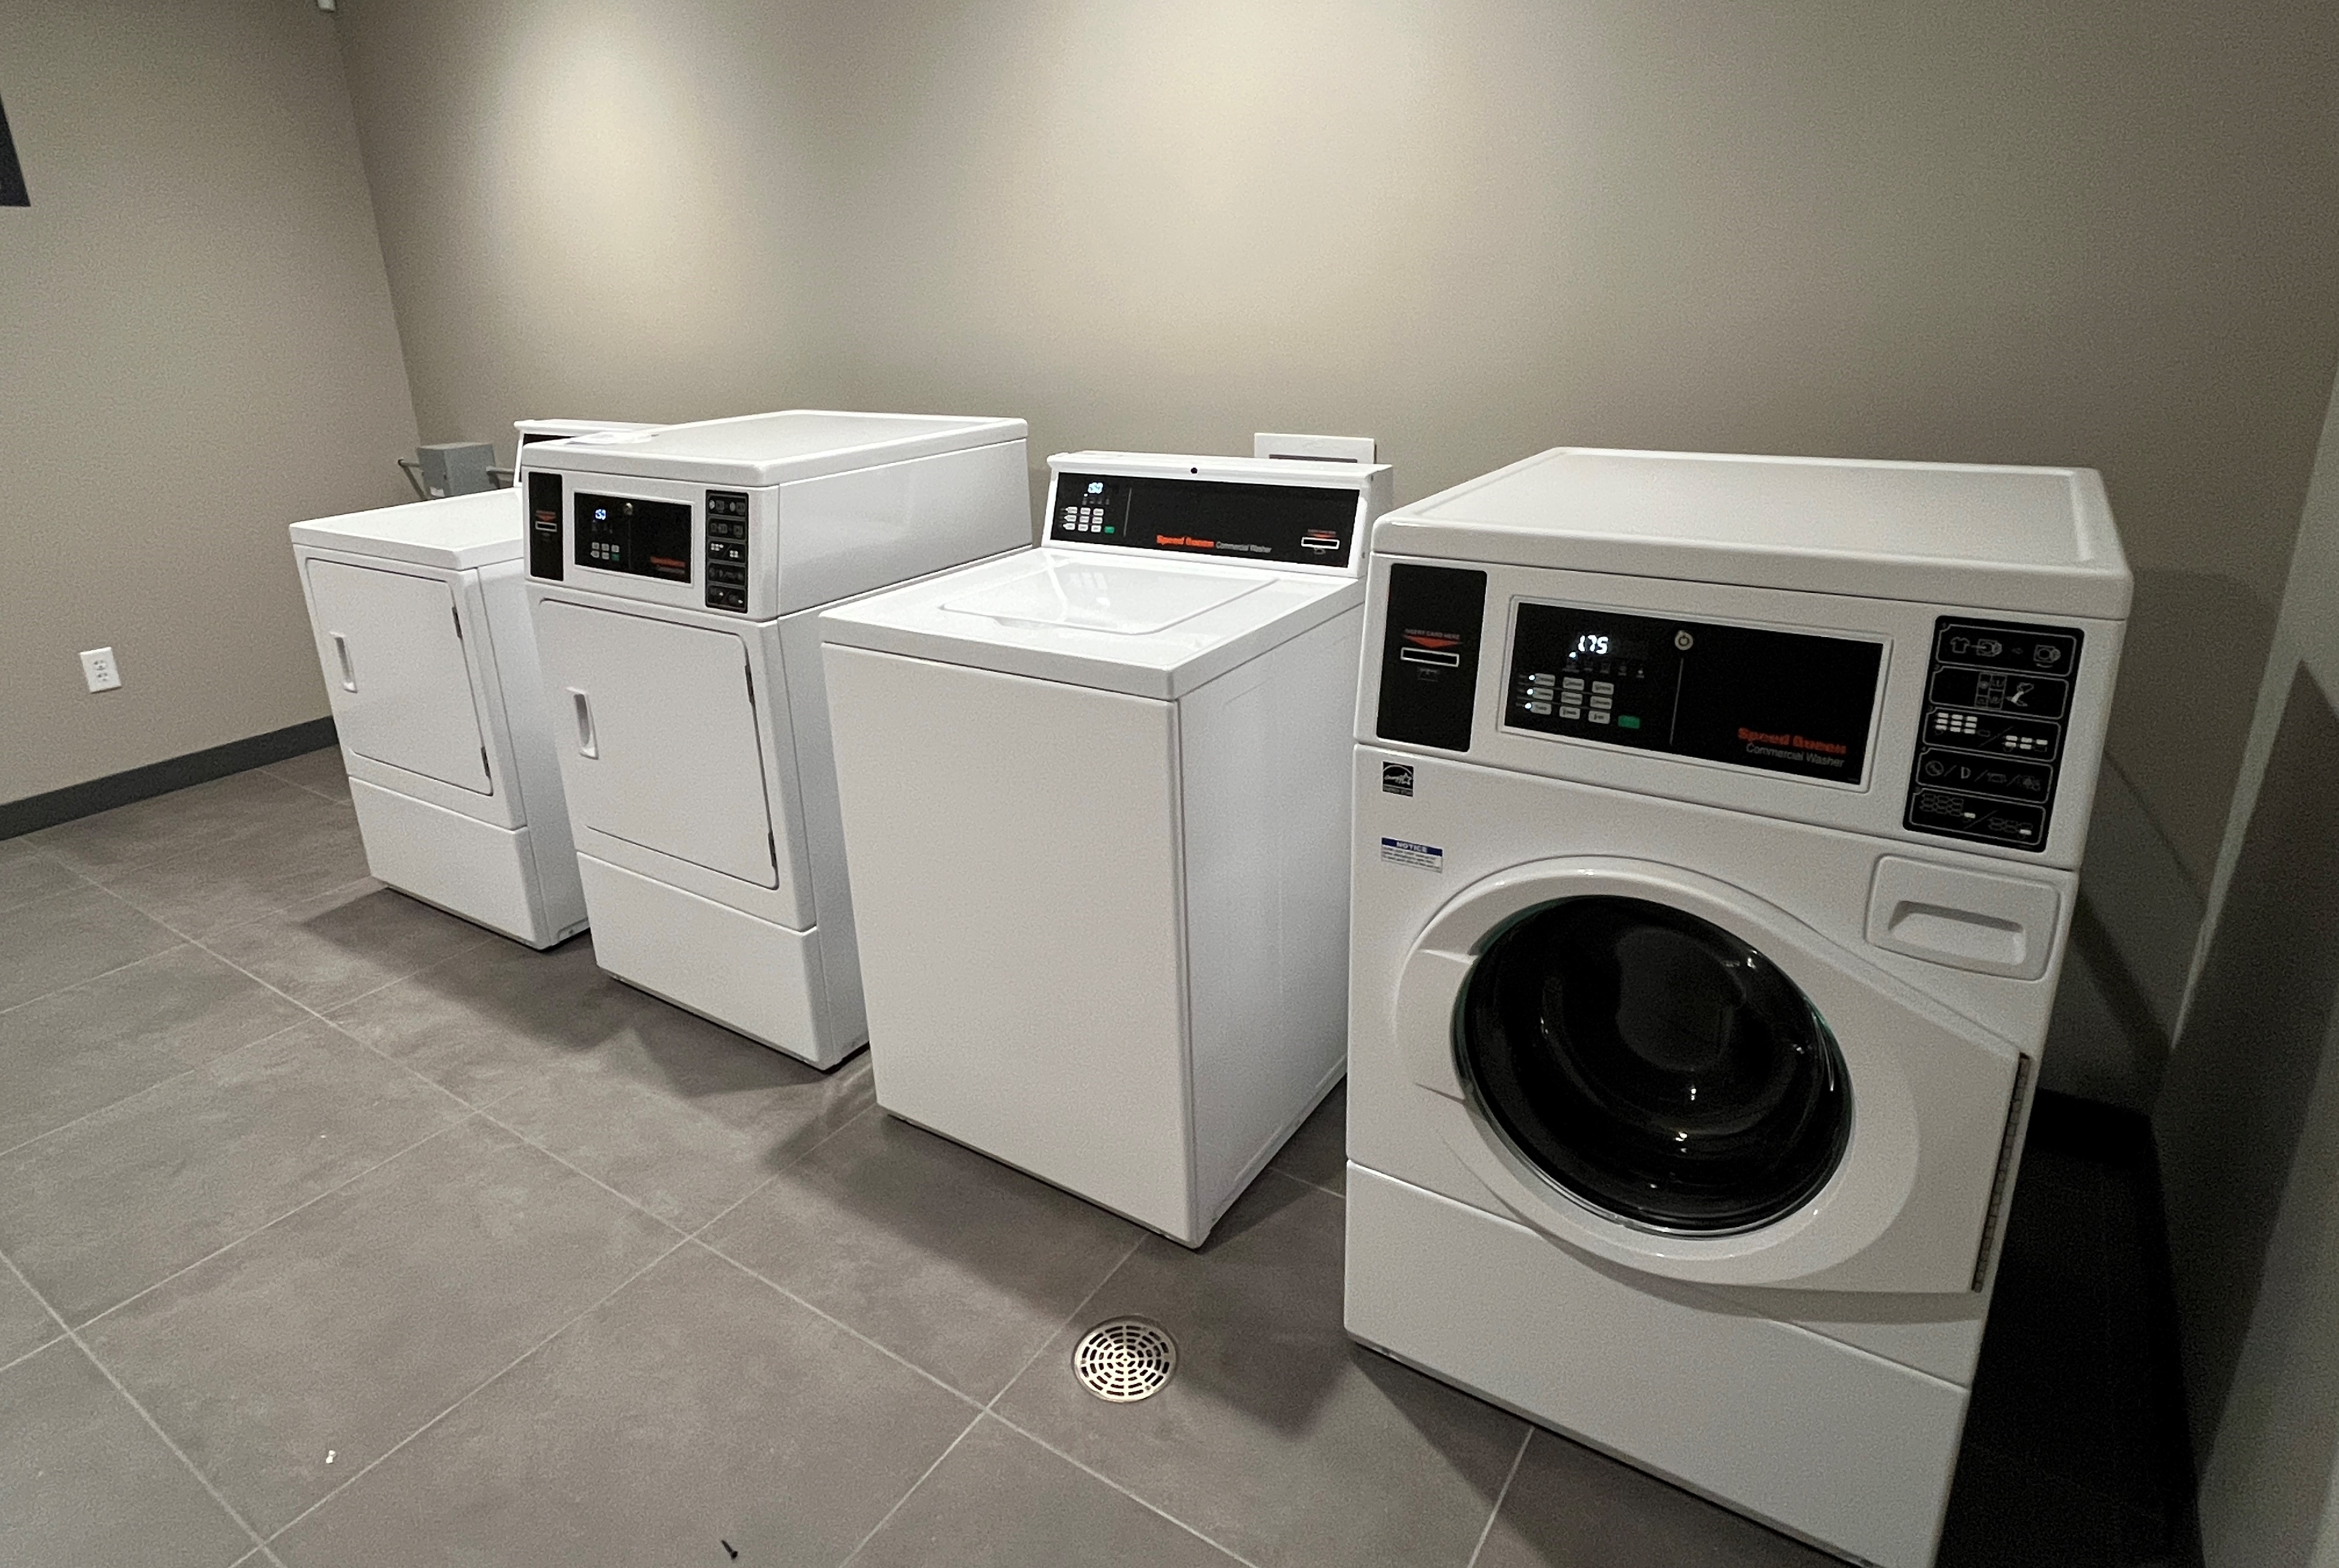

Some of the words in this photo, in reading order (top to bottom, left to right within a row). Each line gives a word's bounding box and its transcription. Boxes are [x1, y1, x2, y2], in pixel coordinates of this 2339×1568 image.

[1738, 727, 1790, 745] Speed
[1793, 735, 1847, 754] Queen
[1746, 742, 1804, 761] Commercial
[1806, 752, 1845, 767] Washer
[1396, 841, 1427, 854] NOTICE
